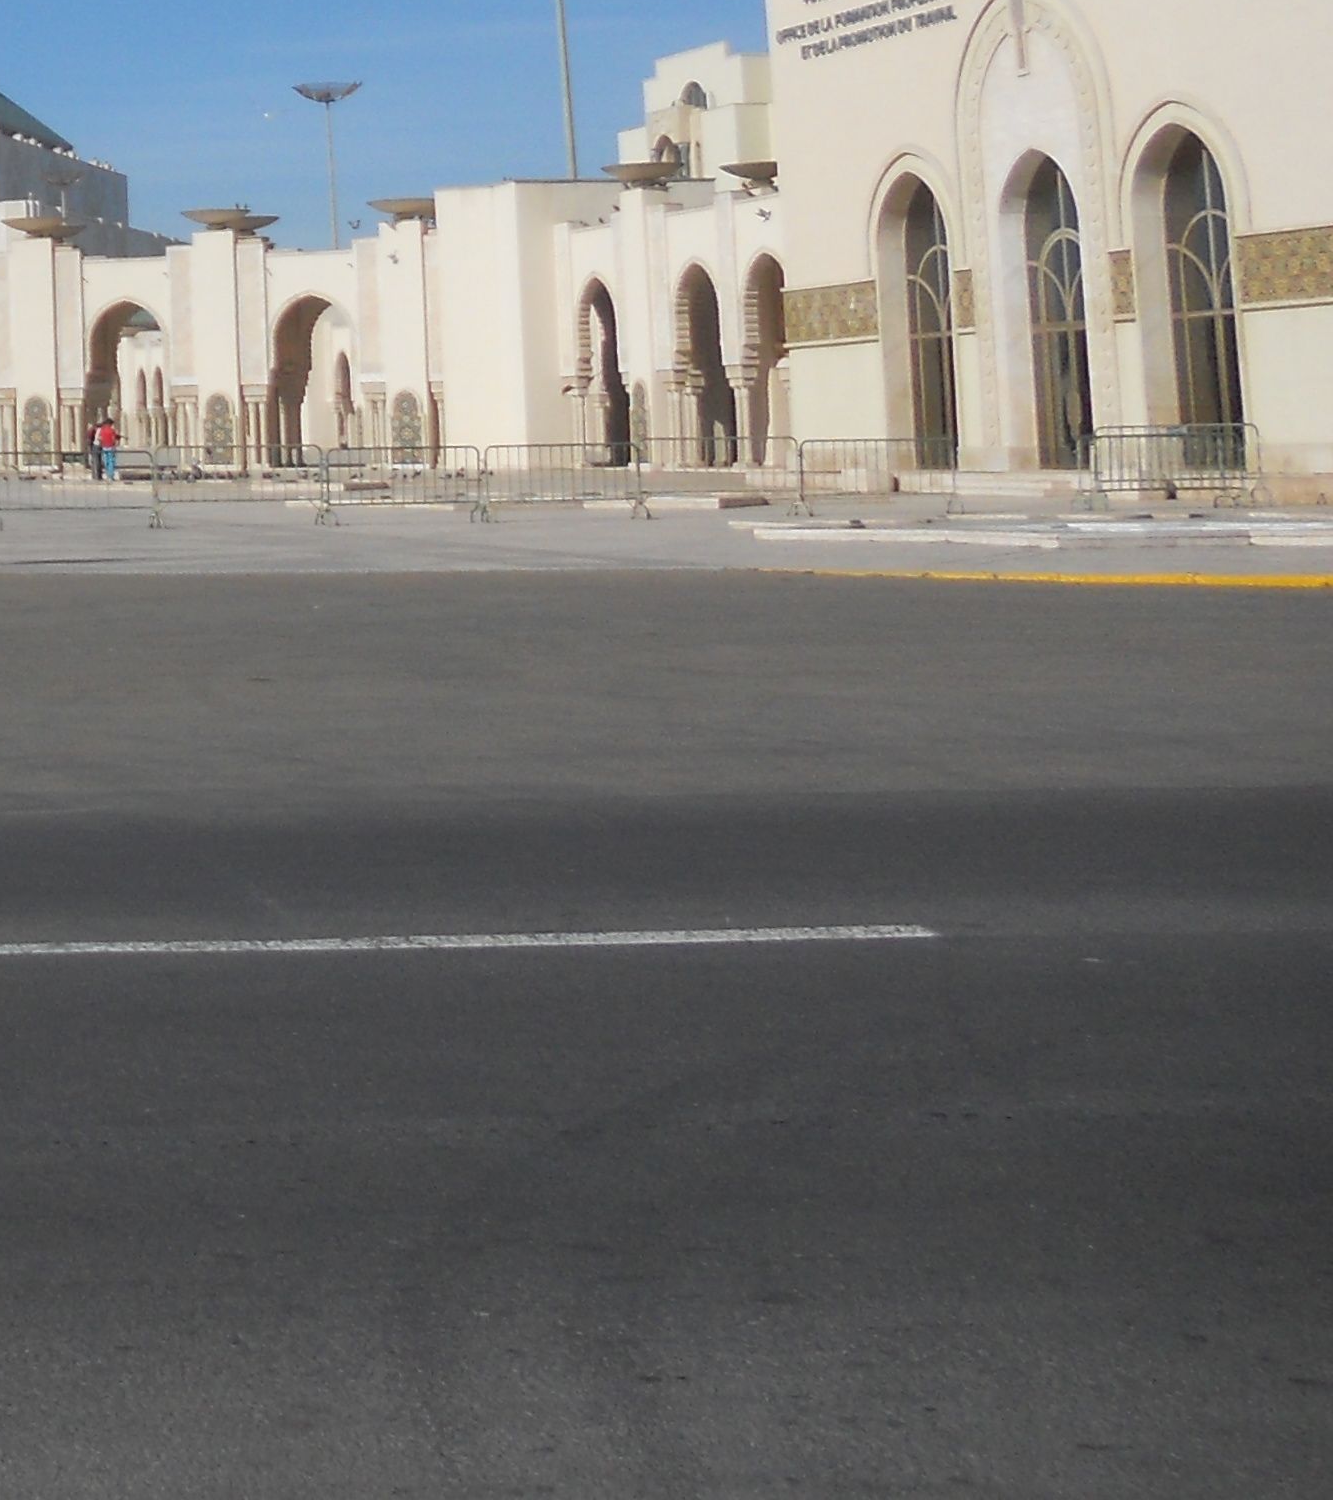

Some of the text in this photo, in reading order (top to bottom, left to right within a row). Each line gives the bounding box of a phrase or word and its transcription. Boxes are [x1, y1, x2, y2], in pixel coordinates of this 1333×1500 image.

[776, 24, 806, 44] OFFICE
[835, 0, 890, 28] FORMATION
[915, 5, 957, 29] TRAVAIL
